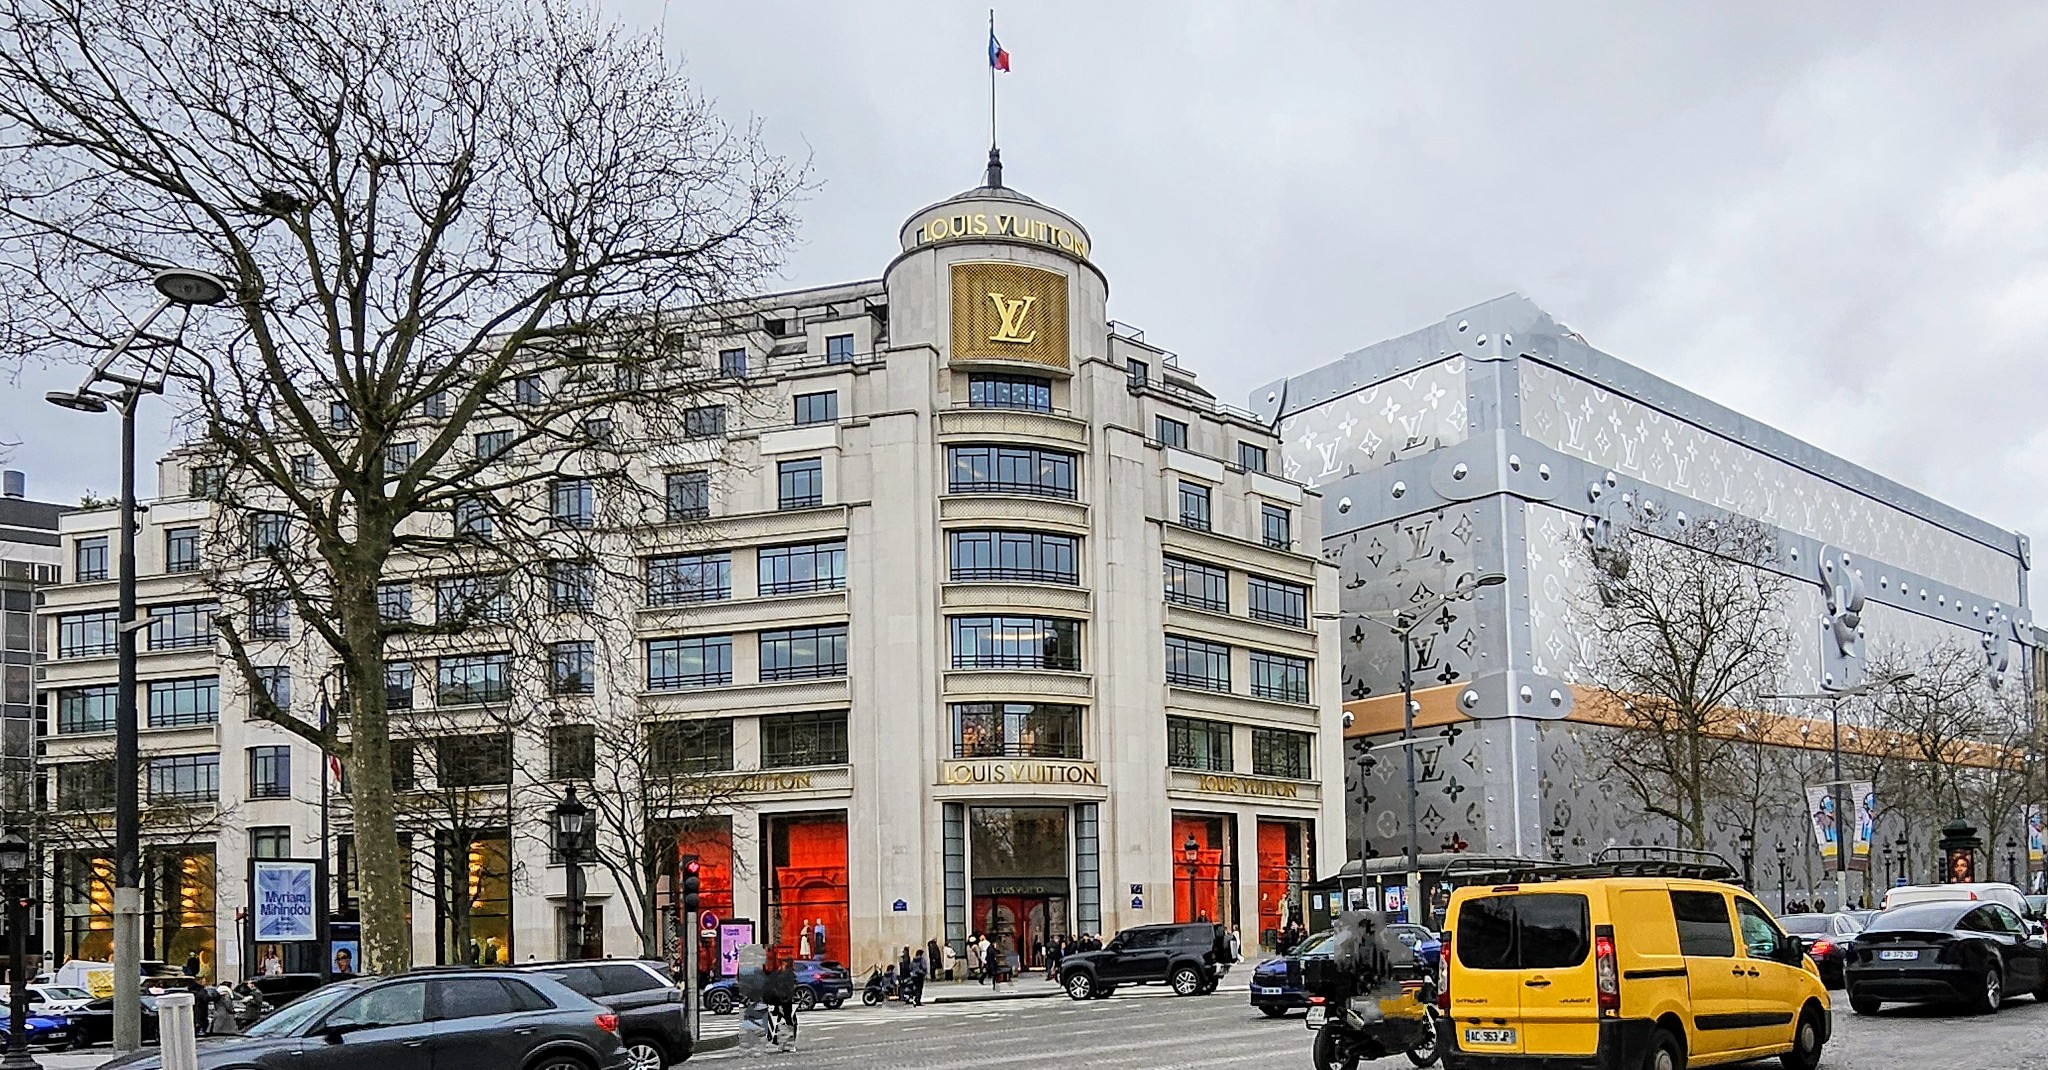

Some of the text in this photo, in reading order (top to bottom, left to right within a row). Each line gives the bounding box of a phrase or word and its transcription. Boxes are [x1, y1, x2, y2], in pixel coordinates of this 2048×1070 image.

[923, 213, 1087, 257] LOUIS VUITTON
[988, 292, 1037, 344] LV
[945, 763, 1098, 784] LOUIS VUITTON
[265, 891, 307, 904] Myriam
[260, 904, 311, 916] Mihindou
